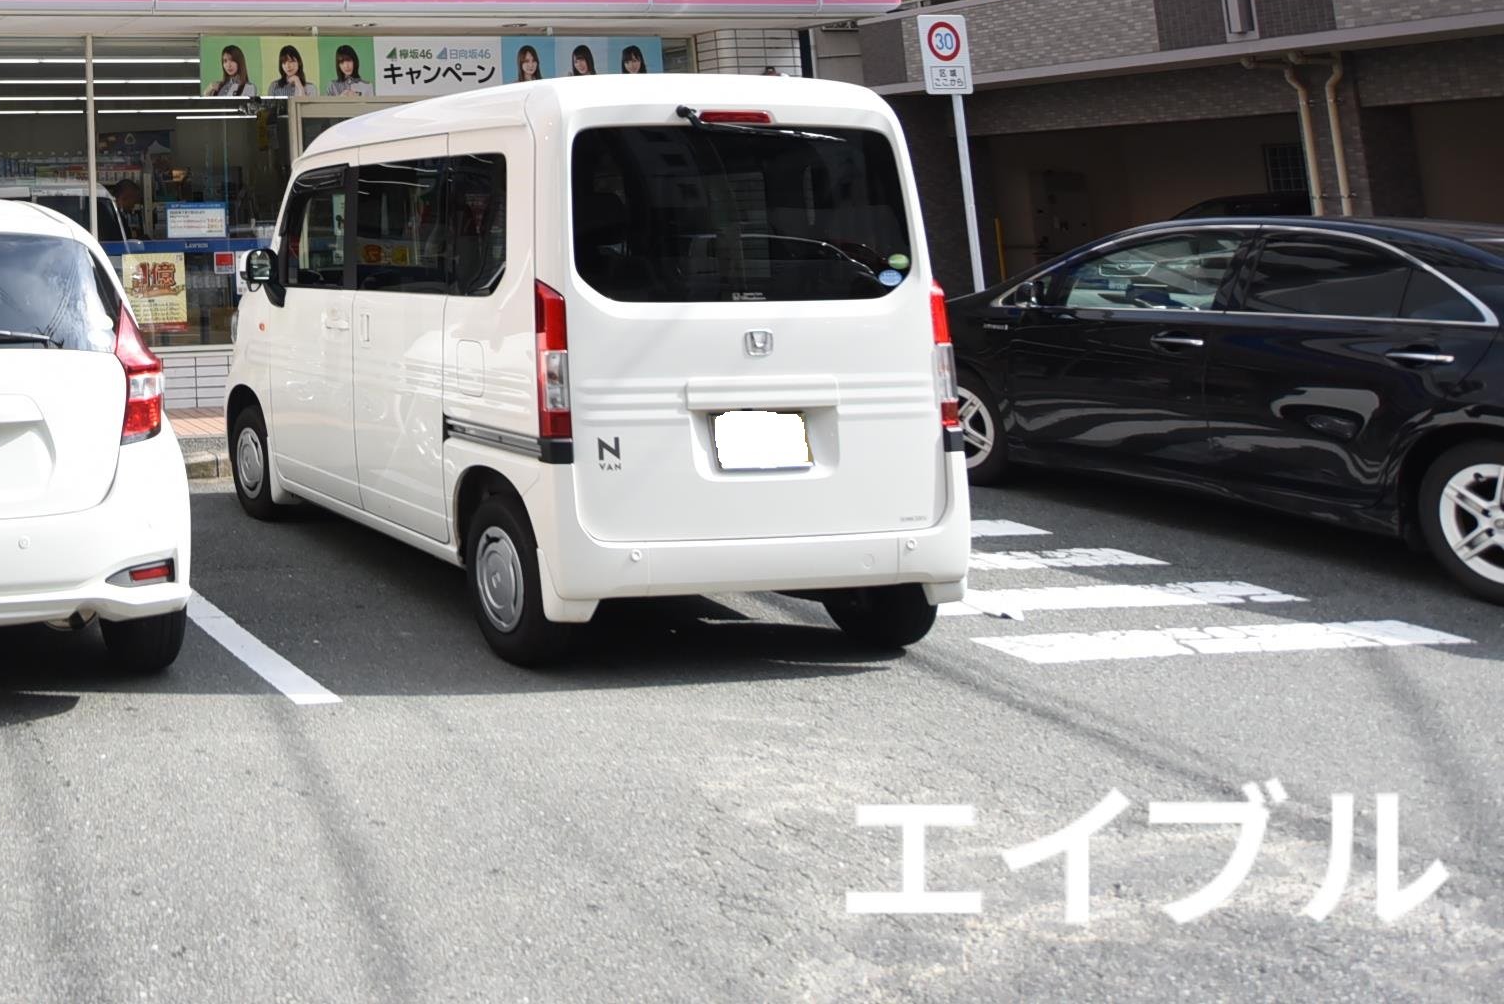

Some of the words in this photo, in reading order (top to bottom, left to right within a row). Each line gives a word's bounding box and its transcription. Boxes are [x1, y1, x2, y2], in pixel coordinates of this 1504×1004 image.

[934, 32, 954, 51] 30
[399, 48, 433, 60] 欅坂46
[449, 48, 492, 60] 日向坂46
[383, 62, 496, 85] キャンペーン
[934, 78, 964, 87] ここから
[597, 436, 621, 461] N
